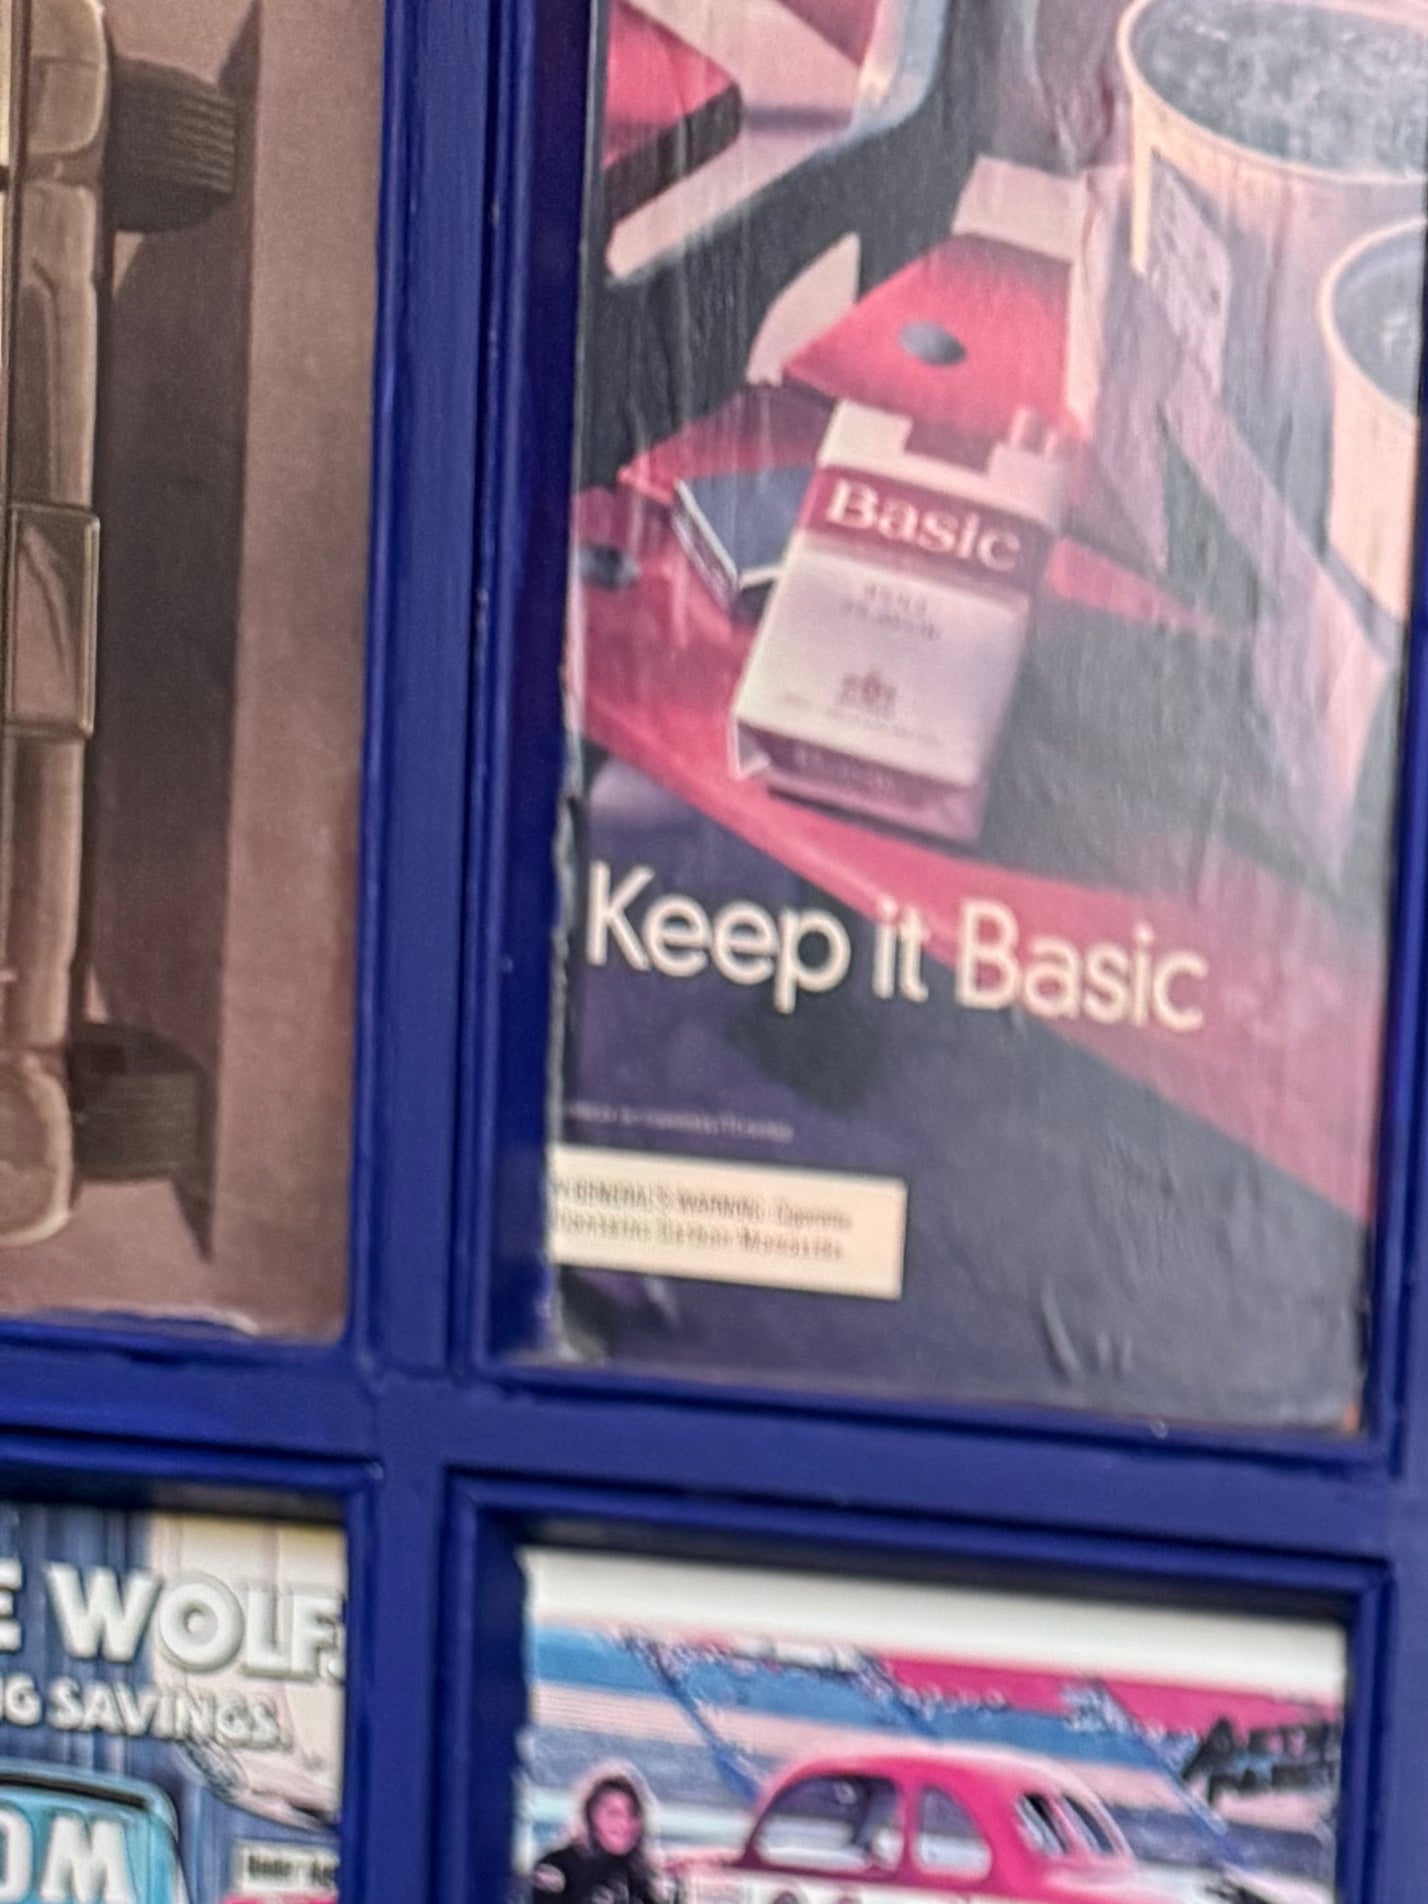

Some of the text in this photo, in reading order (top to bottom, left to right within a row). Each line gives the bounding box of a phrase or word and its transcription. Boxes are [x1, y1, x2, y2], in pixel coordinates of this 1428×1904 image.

[824, 478, 1021, 572] Basic
[586, 860, 1208, 1031] Keep it Basic
